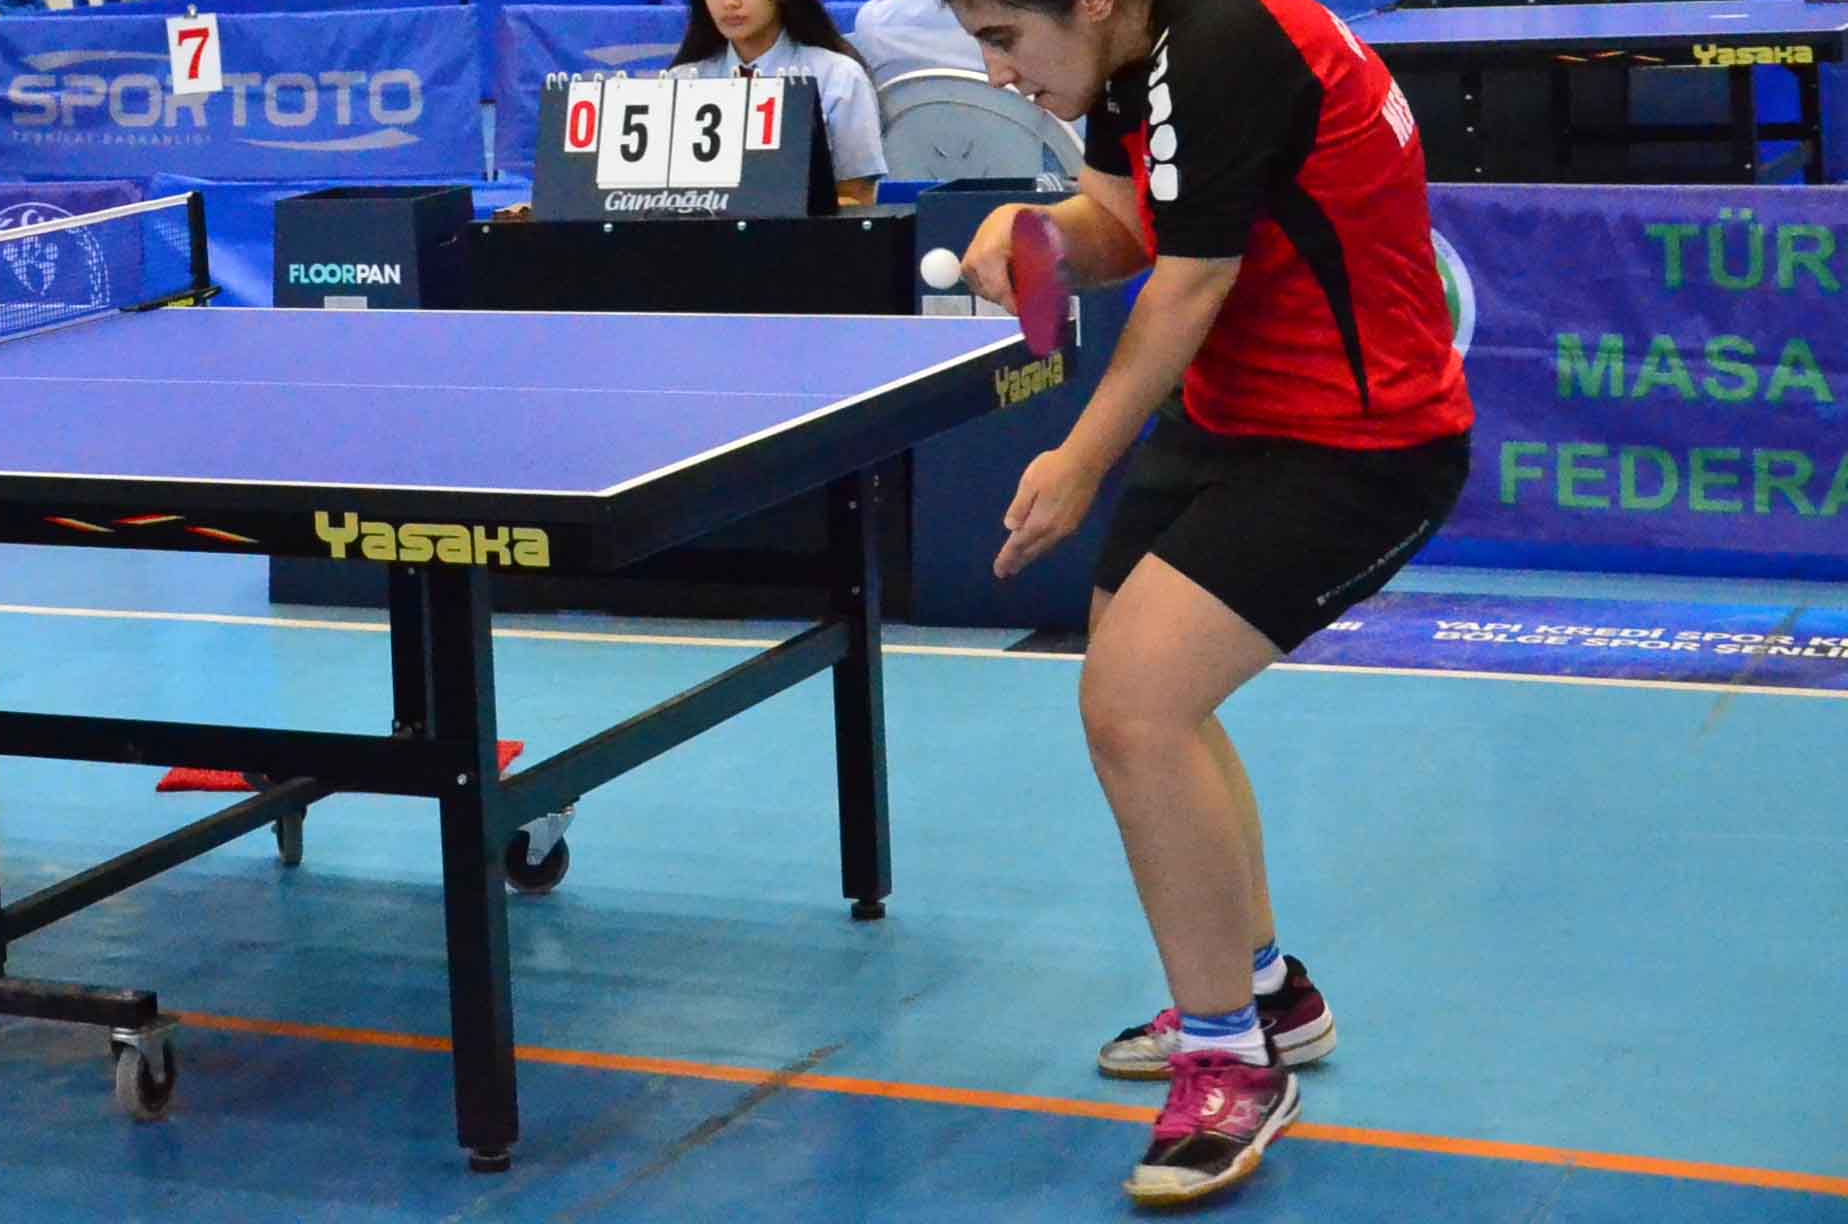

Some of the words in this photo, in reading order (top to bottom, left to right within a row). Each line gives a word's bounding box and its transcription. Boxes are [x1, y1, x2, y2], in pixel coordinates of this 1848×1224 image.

[177, 27, 210, 80] 7
[1693, 43, 1814, 65] Yasaka
[569, 100, 597, 148] 0
[620, 104, 649, 163] 5
[692, 103, 722, 162] 3
[756, 97, 776, 145] 1
[289, 263, 401, 284] FLOORPAN
[1645, 207, 1841, 293] TÜR
[995, 351, 1064, 408] Yasaka
[1557, 332, 1836, 405] MASA
[315, 509, 550, 569] Yasaka
[1435, 621, 1533, 634] YAPI
[1537, 624, 1666, 640] KREDİ
[1677, 630, 1796, 647] SPOR
[1582, 637, 1698, 652] SPOR
